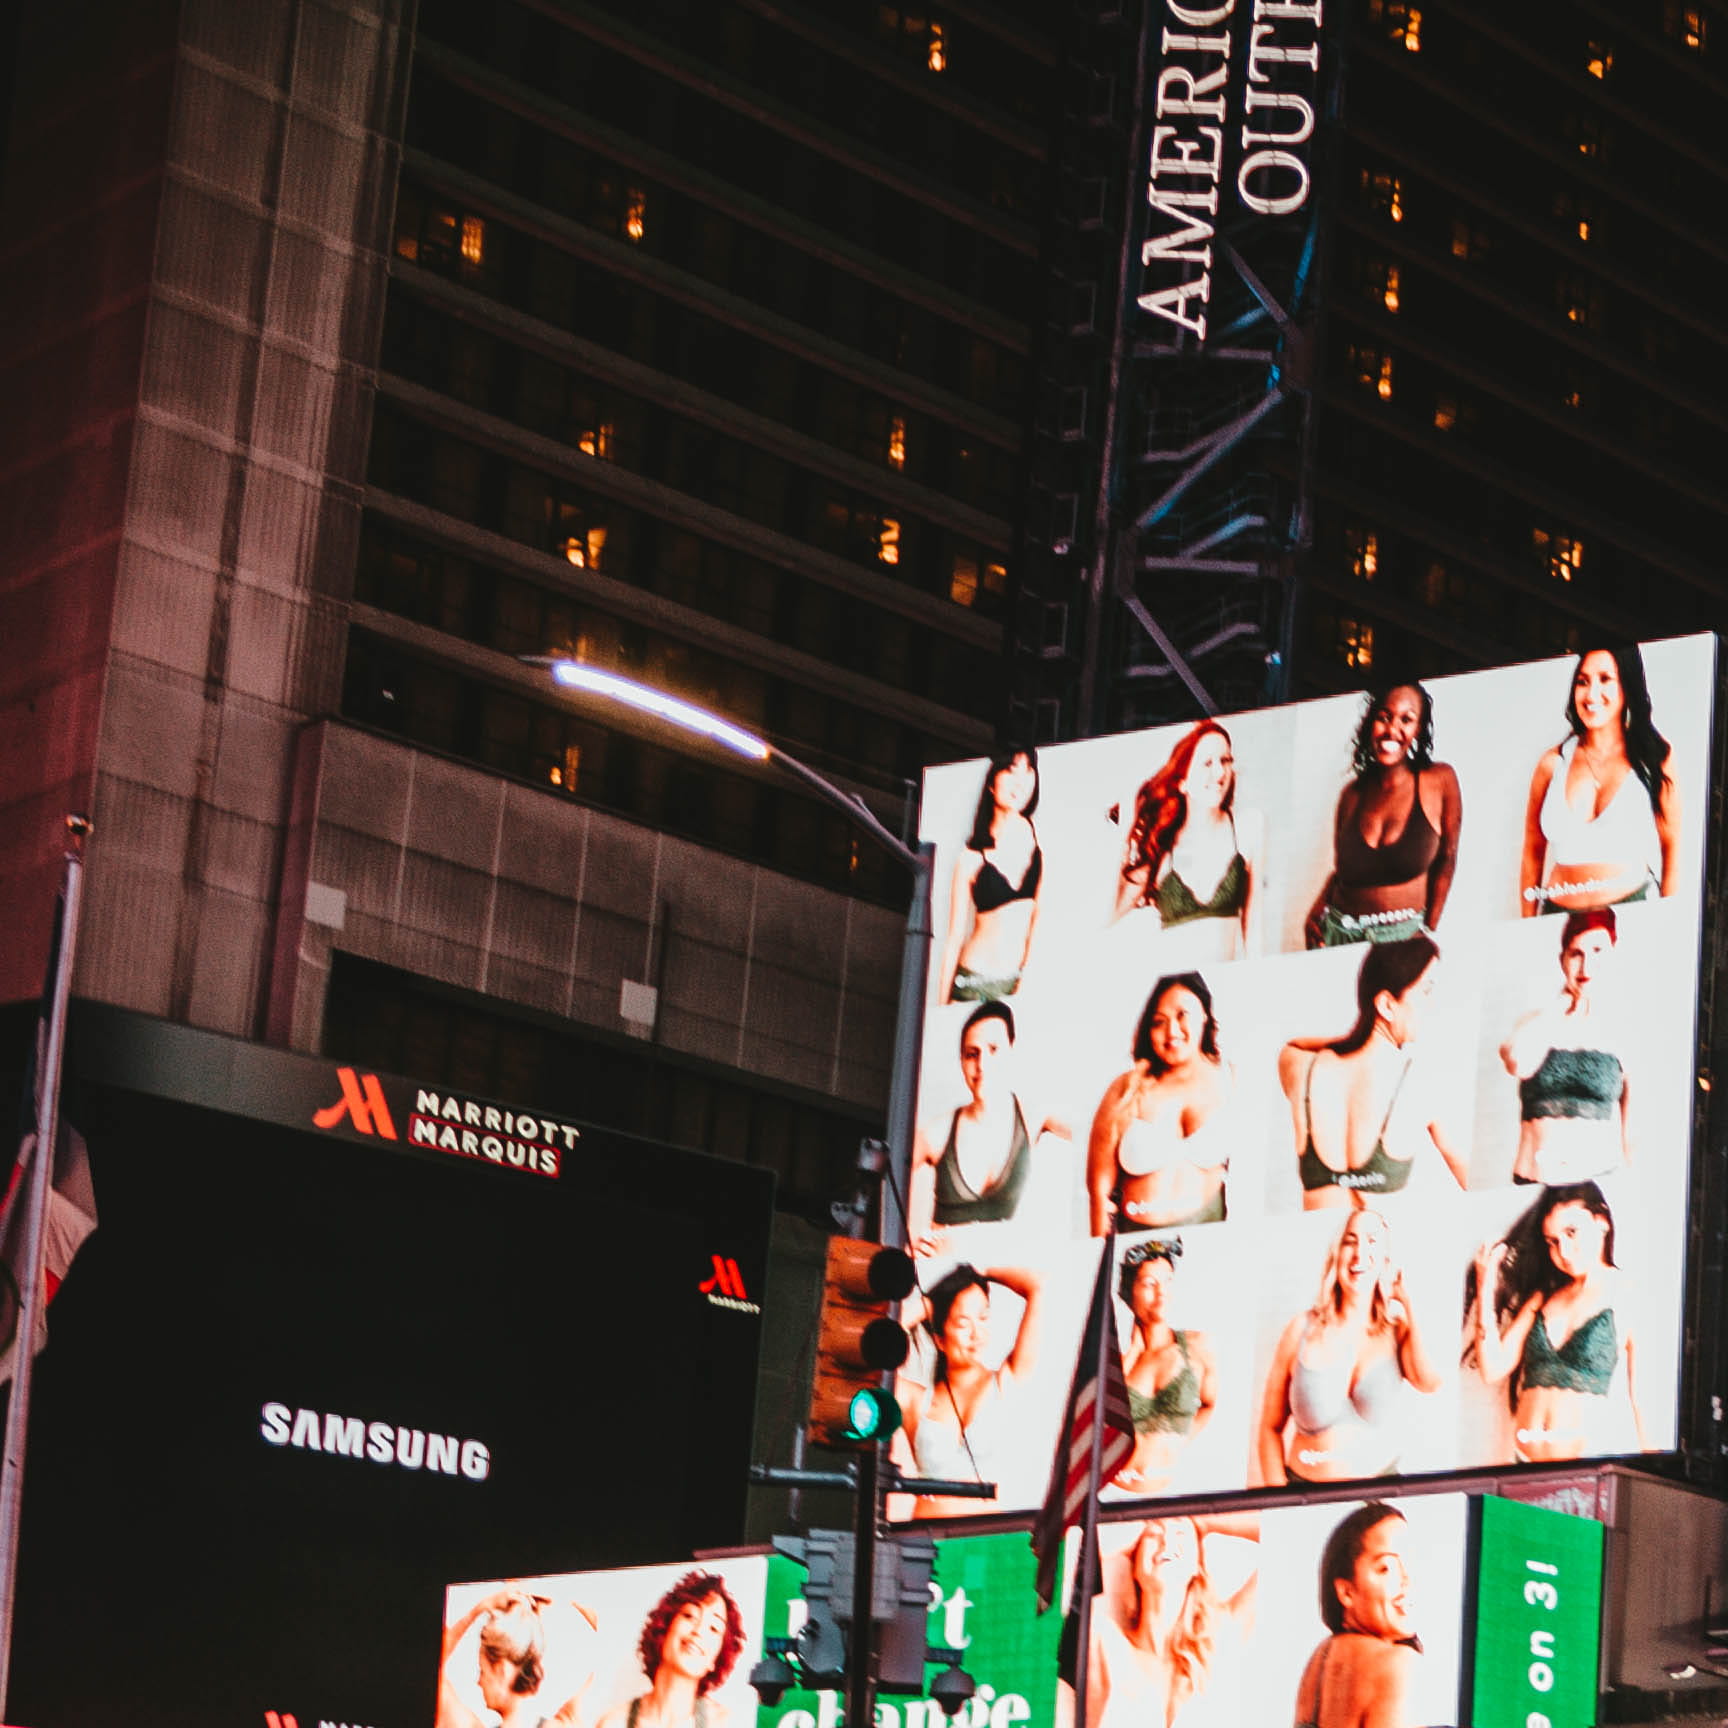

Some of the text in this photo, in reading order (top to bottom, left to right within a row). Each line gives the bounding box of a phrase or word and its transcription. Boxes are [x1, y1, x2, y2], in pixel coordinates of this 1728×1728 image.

[413, 1118, 560, 1175] MARQUIS
[416, 1088, 581, 1149] MARRIOTT
[259, 1400, 491, 1481] SAMSUNG
